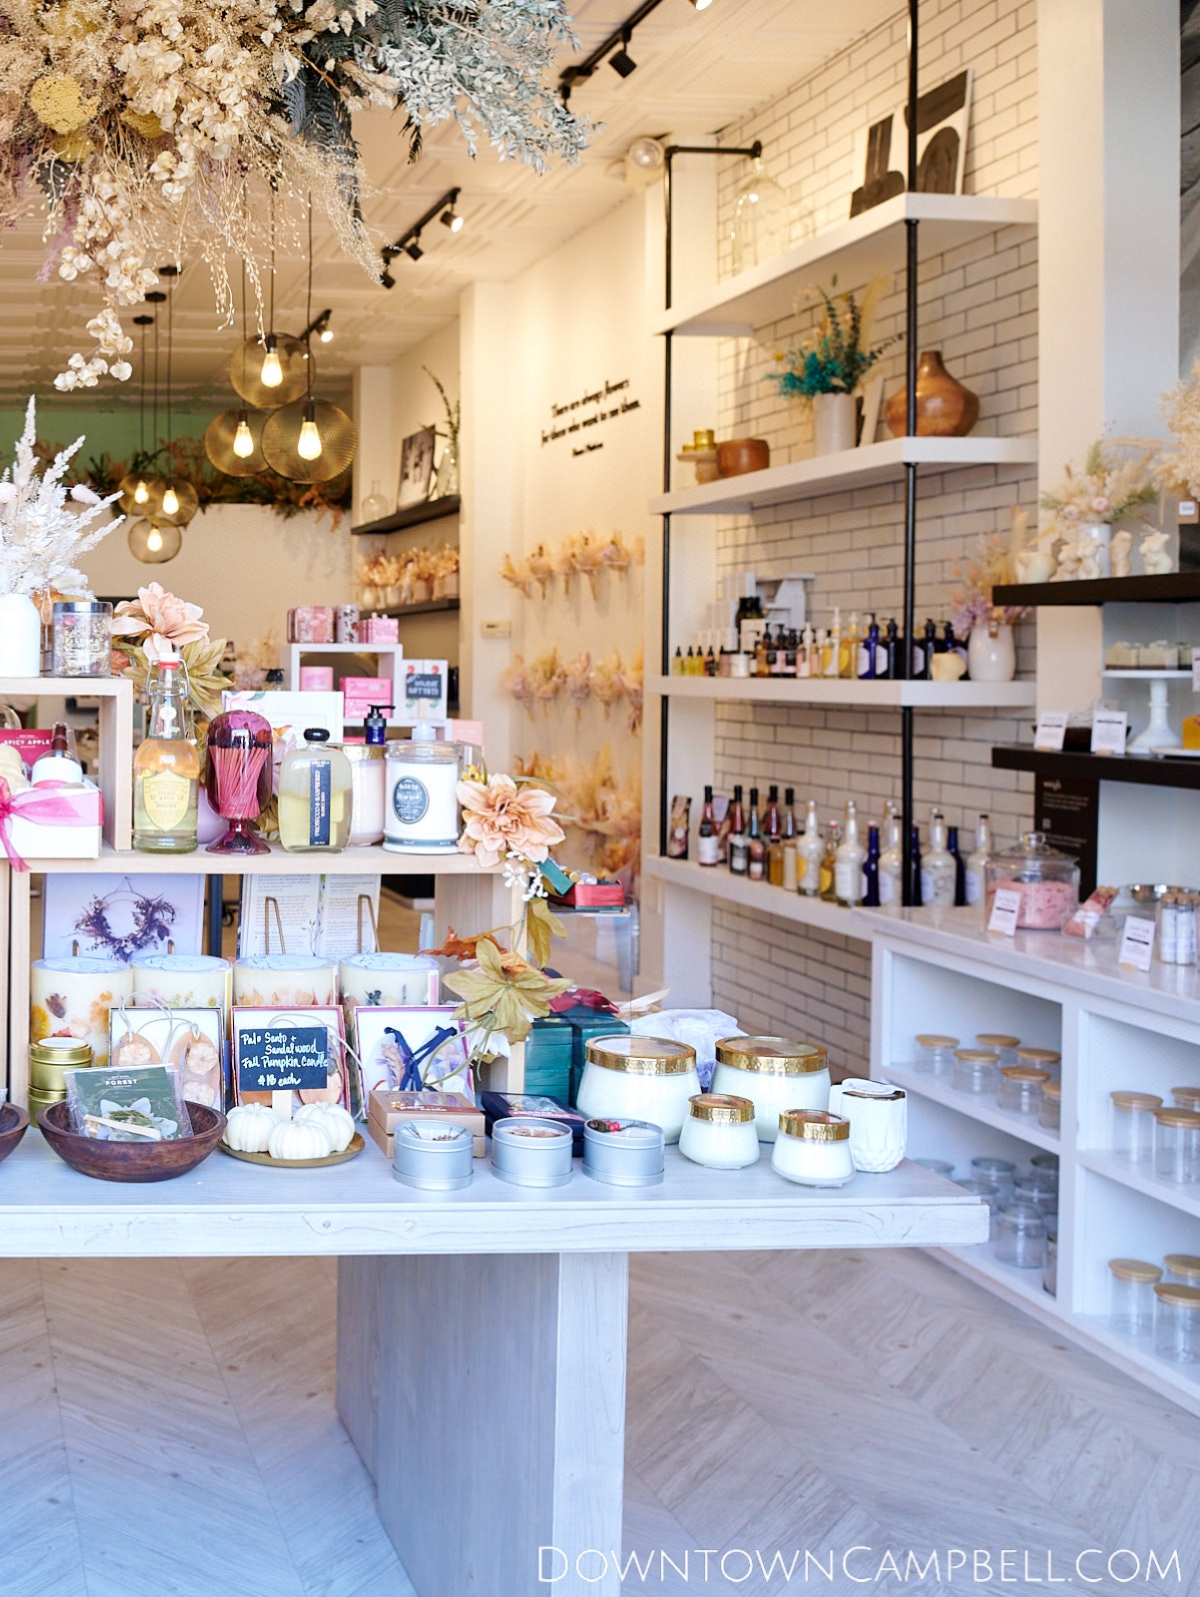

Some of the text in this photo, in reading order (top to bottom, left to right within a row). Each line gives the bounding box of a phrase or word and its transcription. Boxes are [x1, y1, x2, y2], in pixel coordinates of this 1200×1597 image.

[240, 1032, 261, 1045] Palo
[264, 1031, 287, 1043] Santo
[241, 1053, 329, 1072] Fall Pumpkin Candle
[105, 1078, 138, 1086] FOREST
[278, 1072, 302, 1087] each
